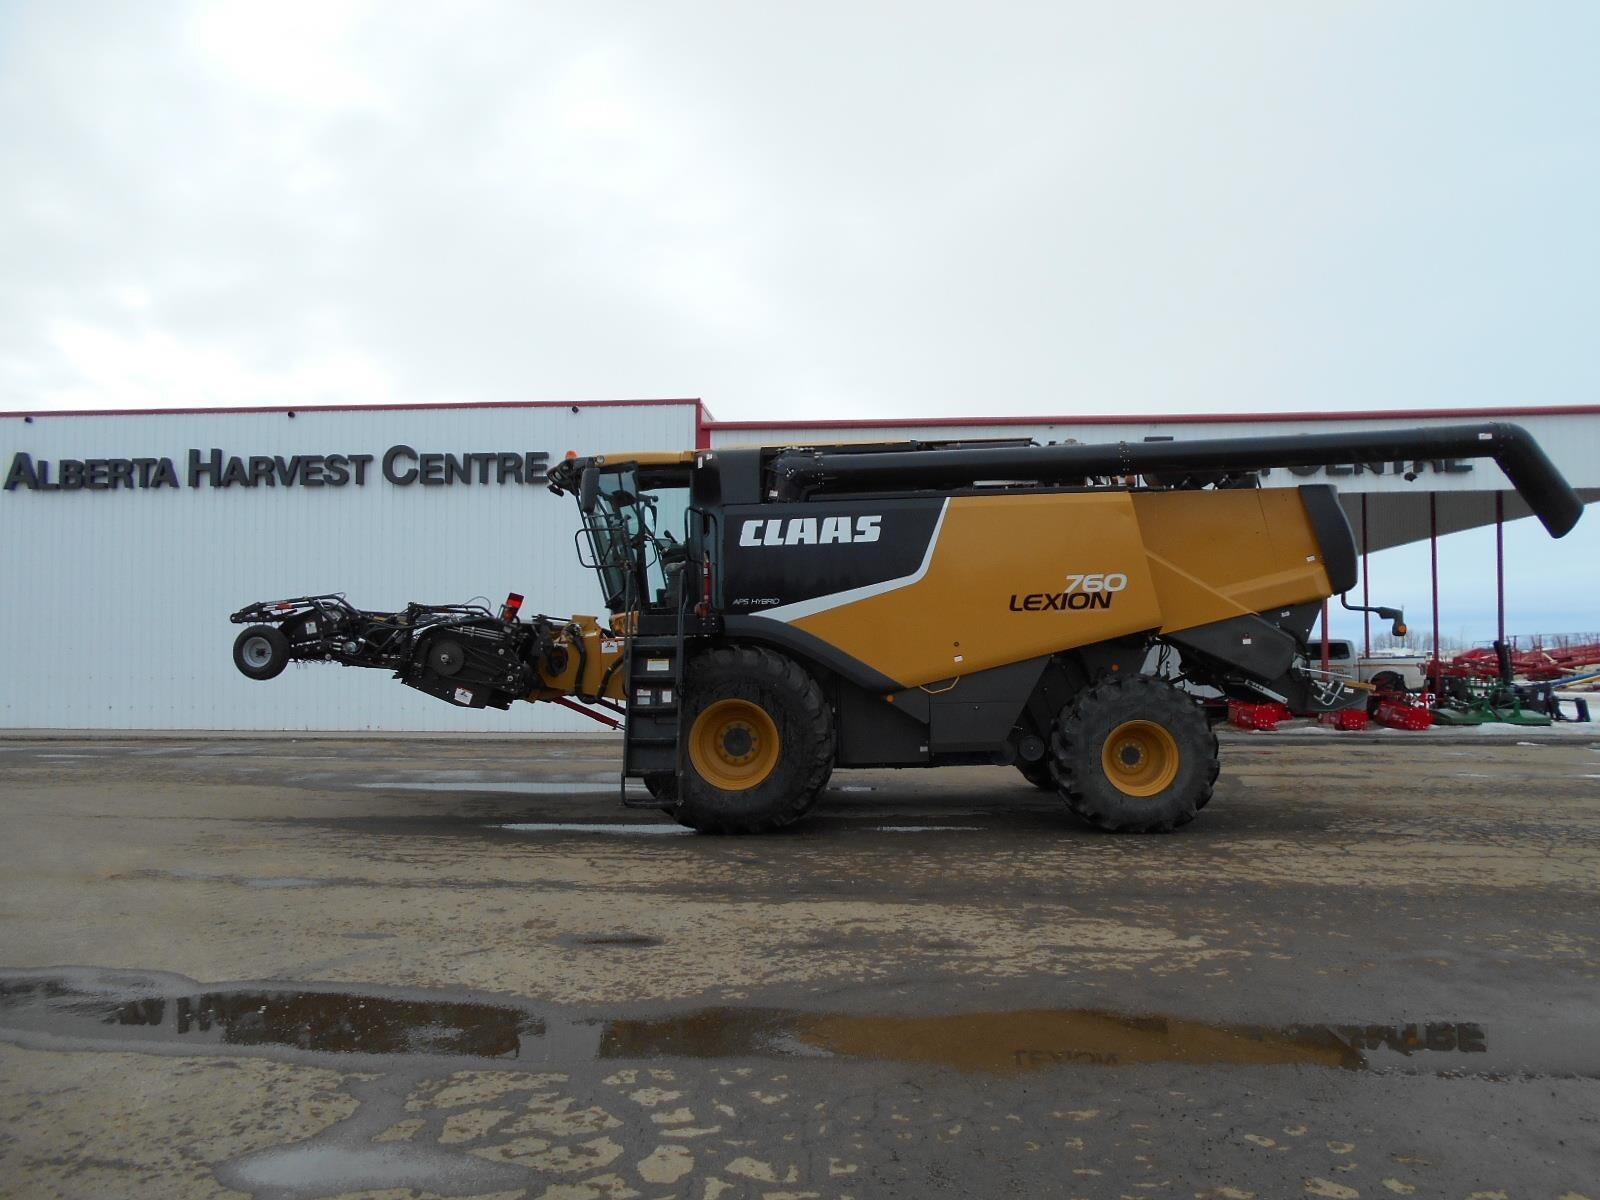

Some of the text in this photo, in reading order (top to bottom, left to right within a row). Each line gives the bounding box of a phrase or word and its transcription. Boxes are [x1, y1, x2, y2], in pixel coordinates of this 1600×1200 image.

[3, 444, 549, 490] ALBERTA HARVEST CENTRE
[739, 515, 882, 547] CLAAS
[1065, 573, 1128, 593] 760
[750, 597, 780, 605] HYBRID
[1009, 591, 1113, 612] LEXION
